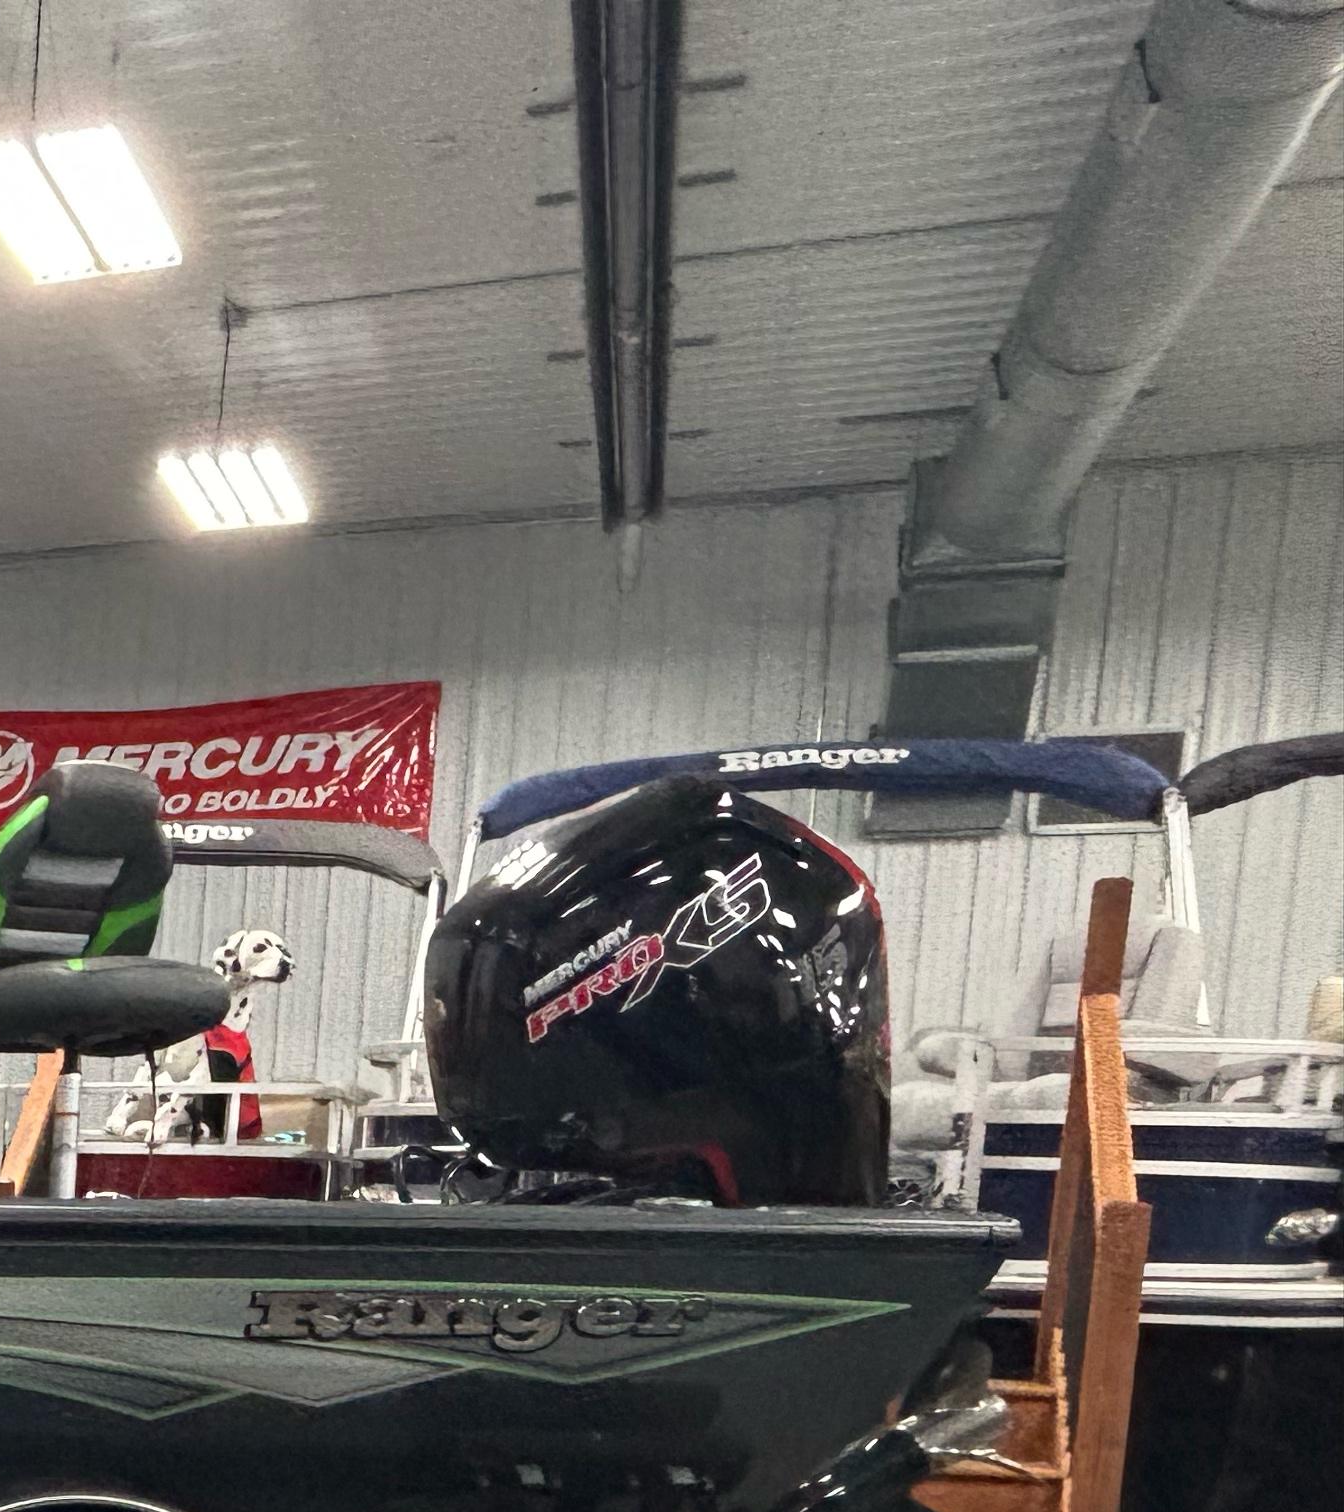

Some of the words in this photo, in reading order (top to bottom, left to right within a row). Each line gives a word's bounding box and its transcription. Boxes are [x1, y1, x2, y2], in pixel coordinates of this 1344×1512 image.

[718, 748, 911, 773] Ranger
[159, 793, 192, 815] O
[161, 822, 254, 845] nger
[524, 919, 633, 1006] MERCURY
[526, 933, 665, 1043] PRO
[243, 1290, 710, 1353] Ranger
